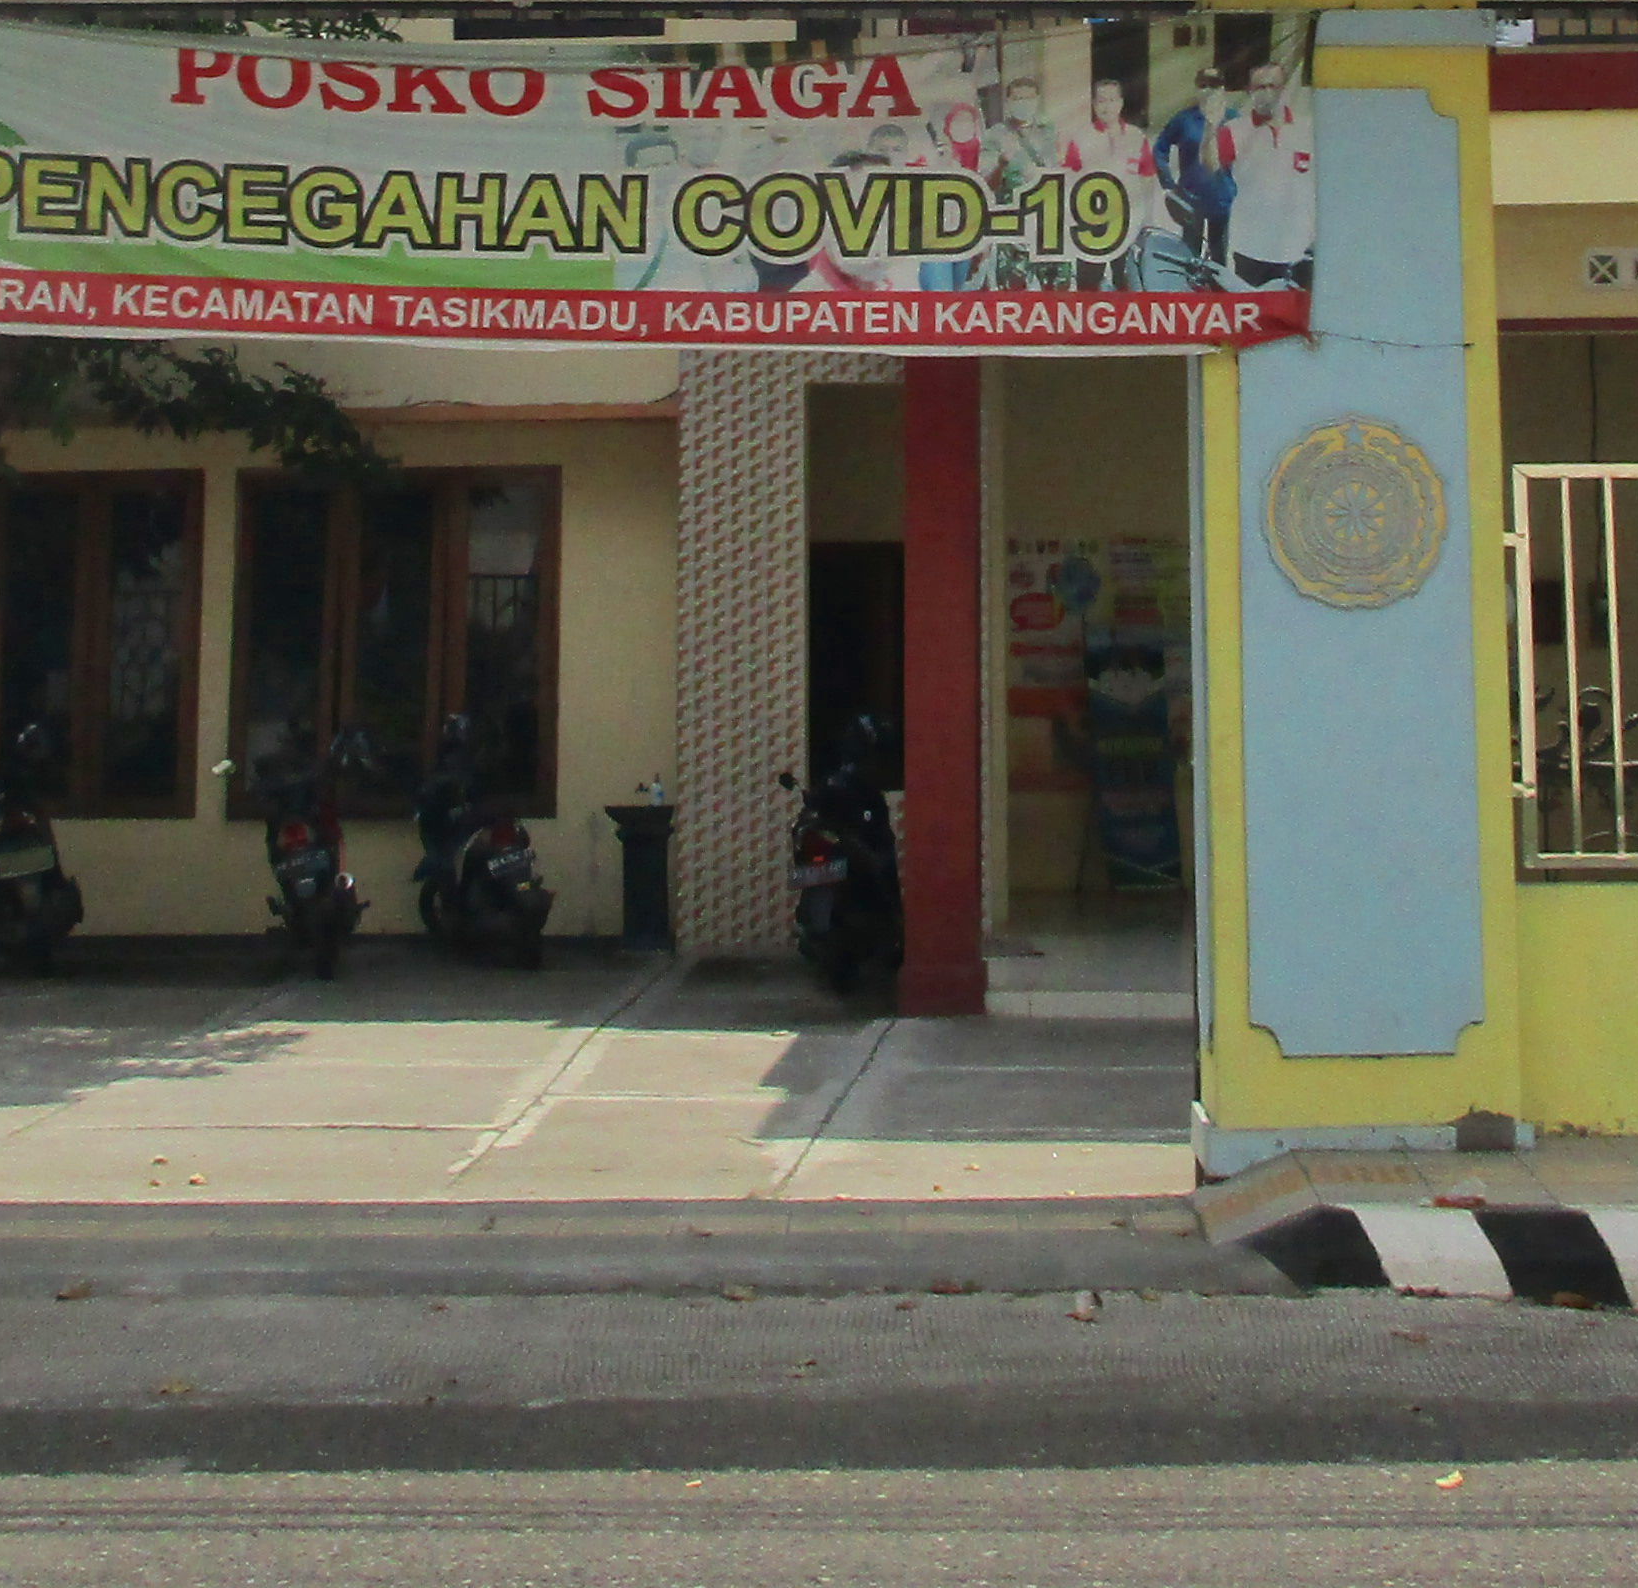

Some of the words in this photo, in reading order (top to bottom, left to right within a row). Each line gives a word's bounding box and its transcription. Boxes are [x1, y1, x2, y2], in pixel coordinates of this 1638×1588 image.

[170, 48, 546, 116] POSKO
[587, 55, 921, 120] SIAGA
[673, 169, 1129, 259] COVID-19
[112, 284, 373, 324] KECAMATAN
[388, 295, 648, 337] TASIKMADU,
[663, 300, 919, 334] KABUPATEN
[934, 300, 1261, 334] KARANGANYAR
